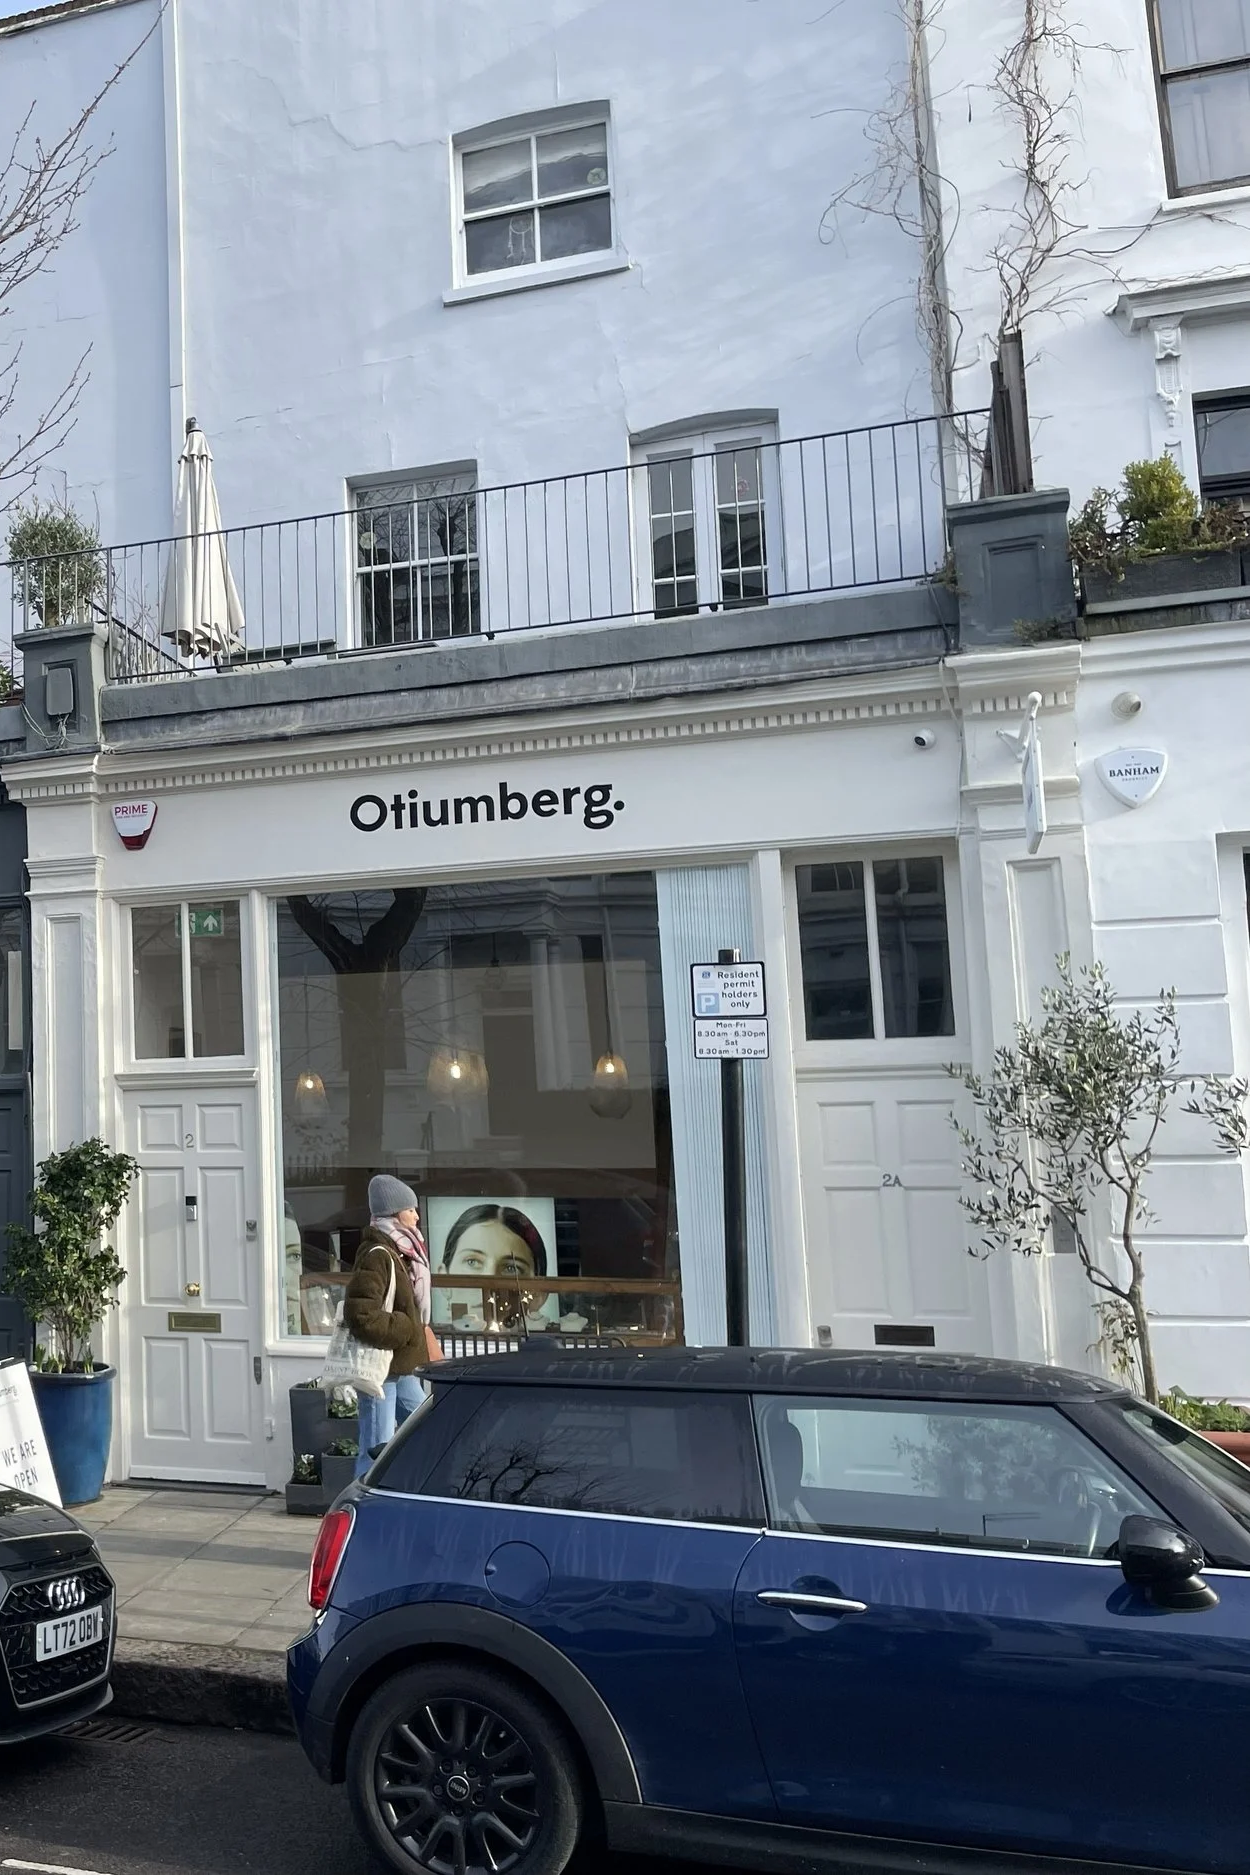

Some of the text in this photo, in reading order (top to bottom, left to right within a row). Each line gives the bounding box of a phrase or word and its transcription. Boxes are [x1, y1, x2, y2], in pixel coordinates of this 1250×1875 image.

[1109, 766, 1159, 777] BANHAM
[114, 804, 148, 816] PRIME
[350, 782, 625, 832] Otiumberg.
[717, 971, 759, 979] Resident
[723, 980, 755, 989] permit
[730, 1000, 750, 1008] only
[185, 1133, 194, 1148] 2
[882, 1173, 902, 1187] 2A
[2, 1439, 37, 1467] WE ARE
[14, 1466, 38, 1489] OPEN
[44, 1619, 76, 1654] LT72
